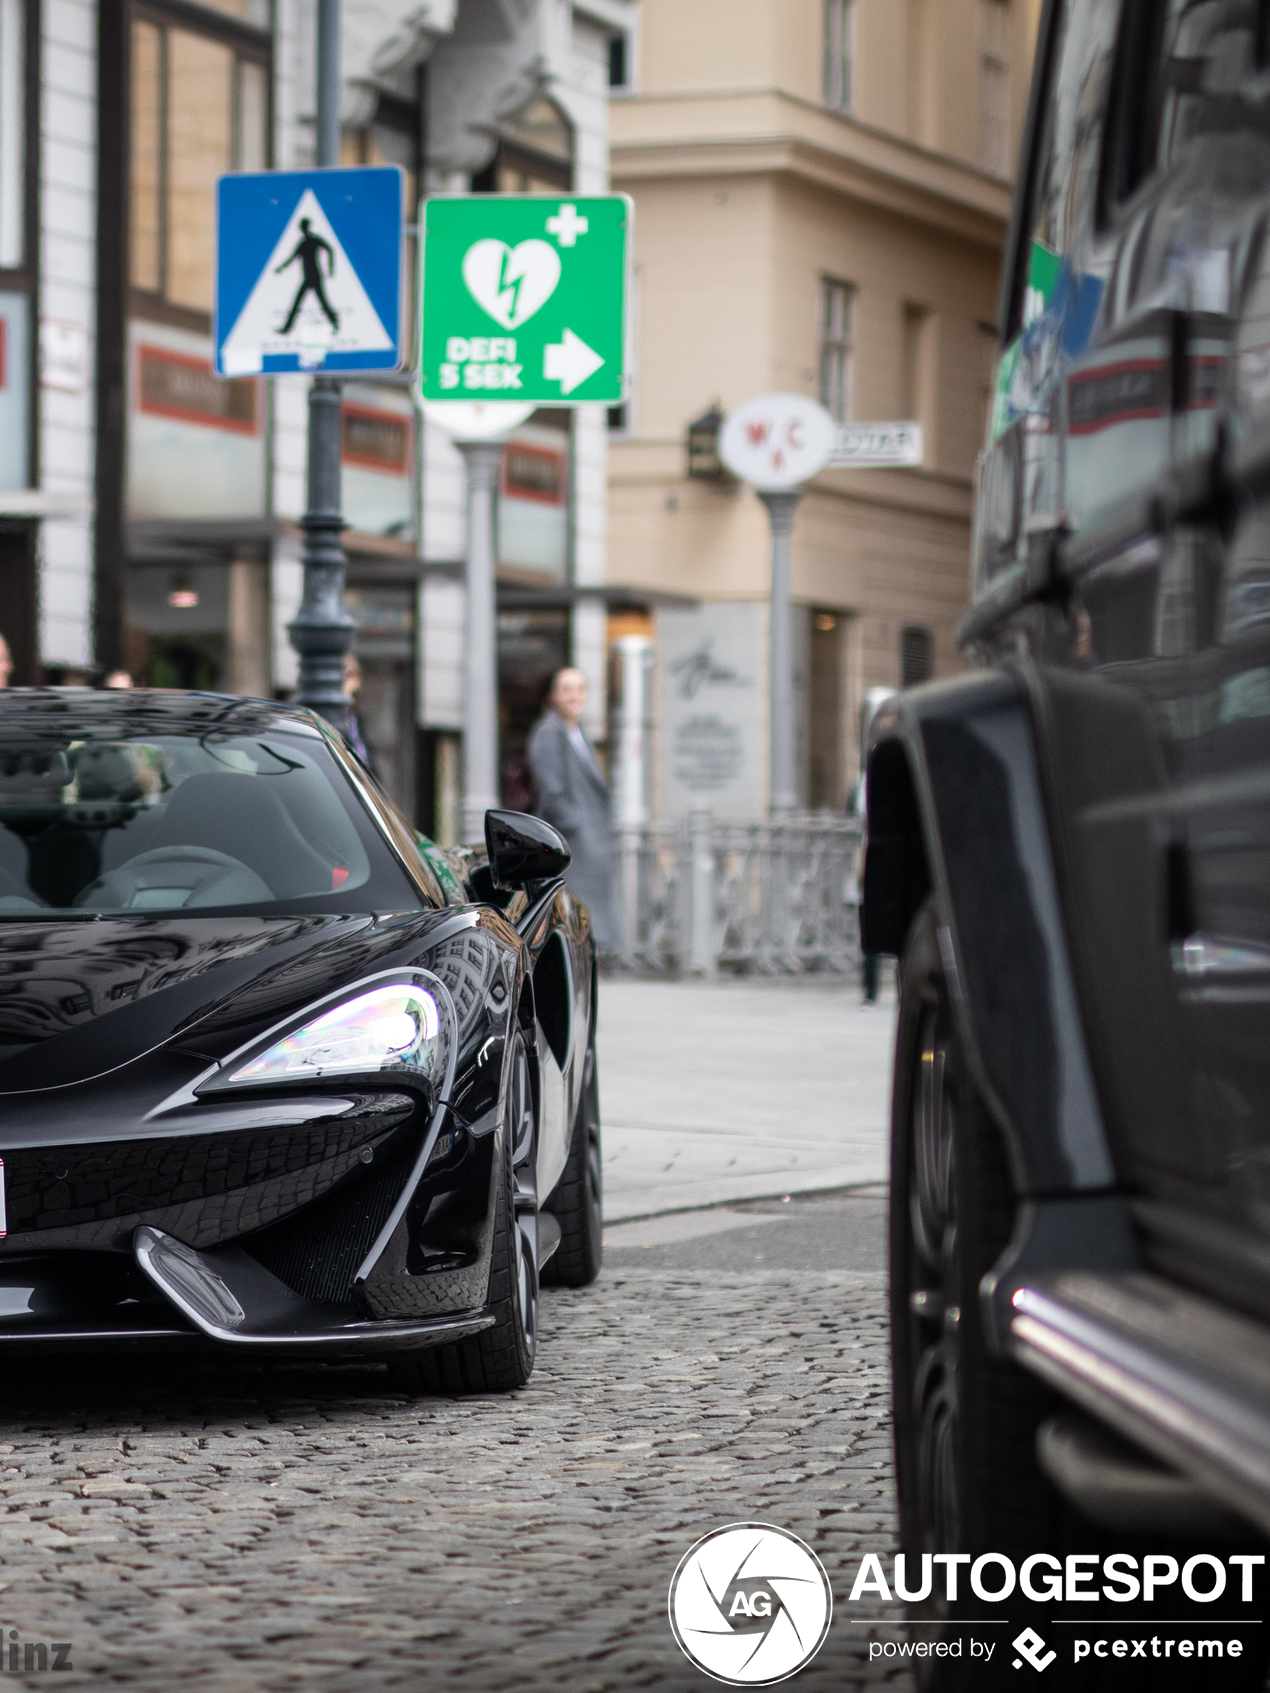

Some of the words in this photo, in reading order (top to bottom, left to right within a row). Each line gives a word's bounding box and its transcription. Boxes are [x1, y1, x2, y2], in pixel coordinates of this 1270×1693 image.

[446, 337, 517, 362] DEFI
[439, 363, 460, 389] 5
[463, 363, 523, 389] SEK
